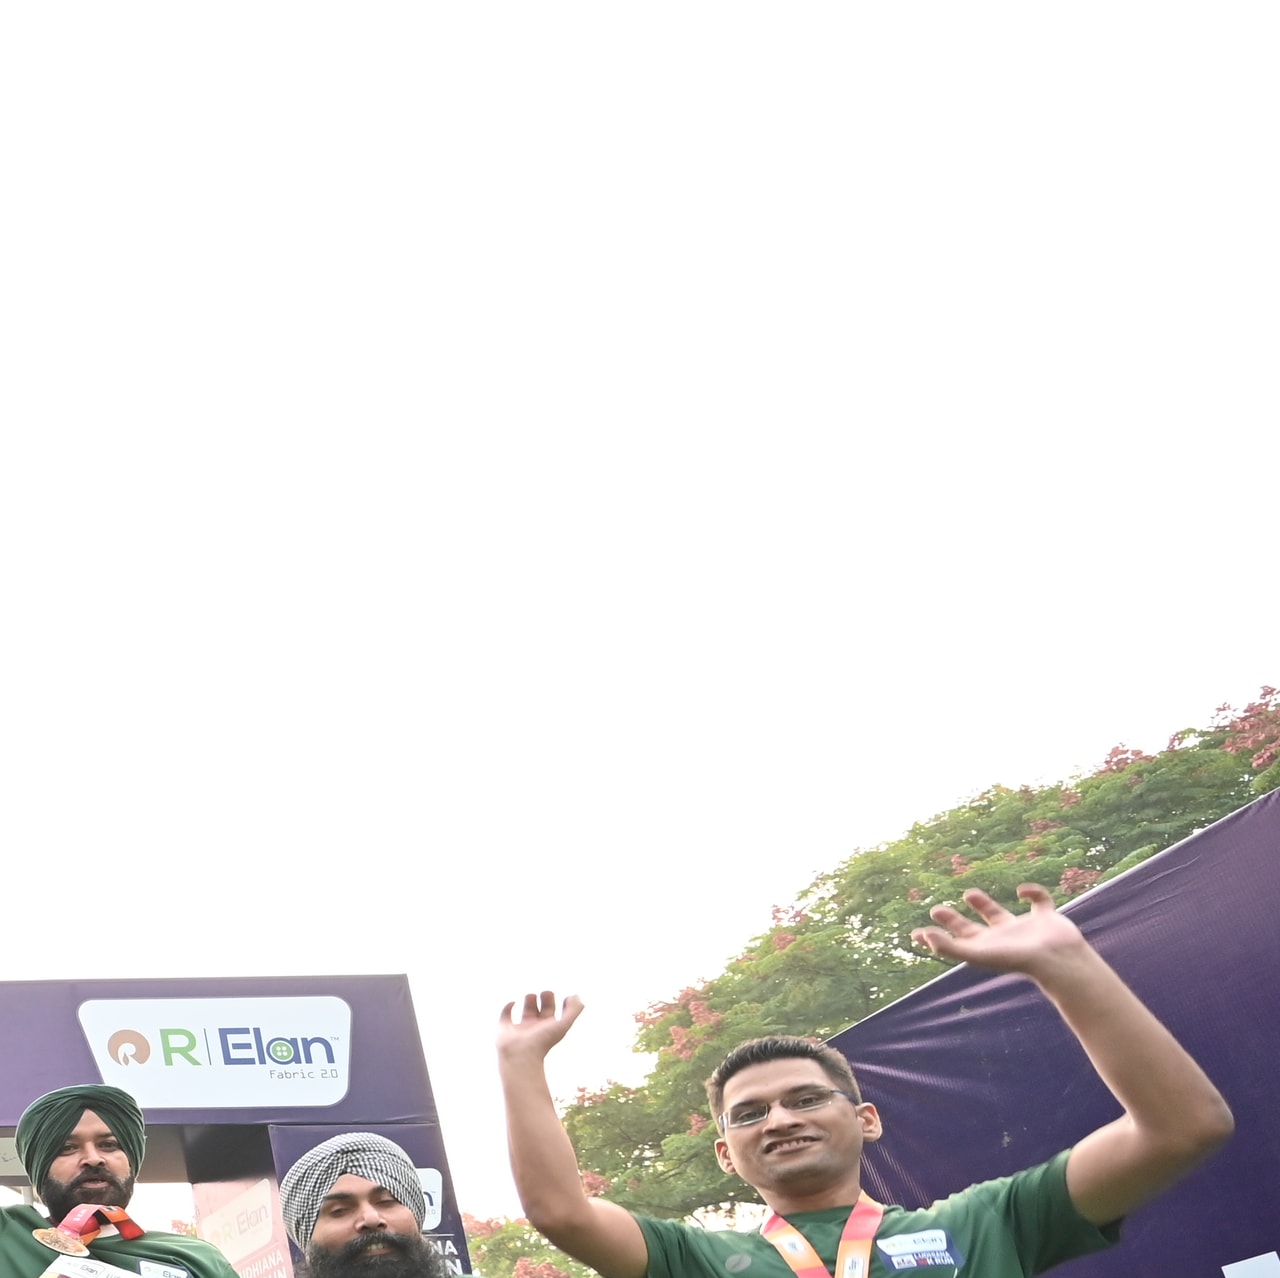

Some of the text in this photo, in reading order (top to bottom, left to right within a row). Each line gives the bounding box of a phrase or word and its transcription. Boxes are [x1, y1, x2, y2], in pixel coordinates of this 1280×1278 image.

[218, 1027, 336, 1067] Elan
[269, 1068, 339, 1080] Fabric 2.0
[935, 1257, 954, 1266] RUN
